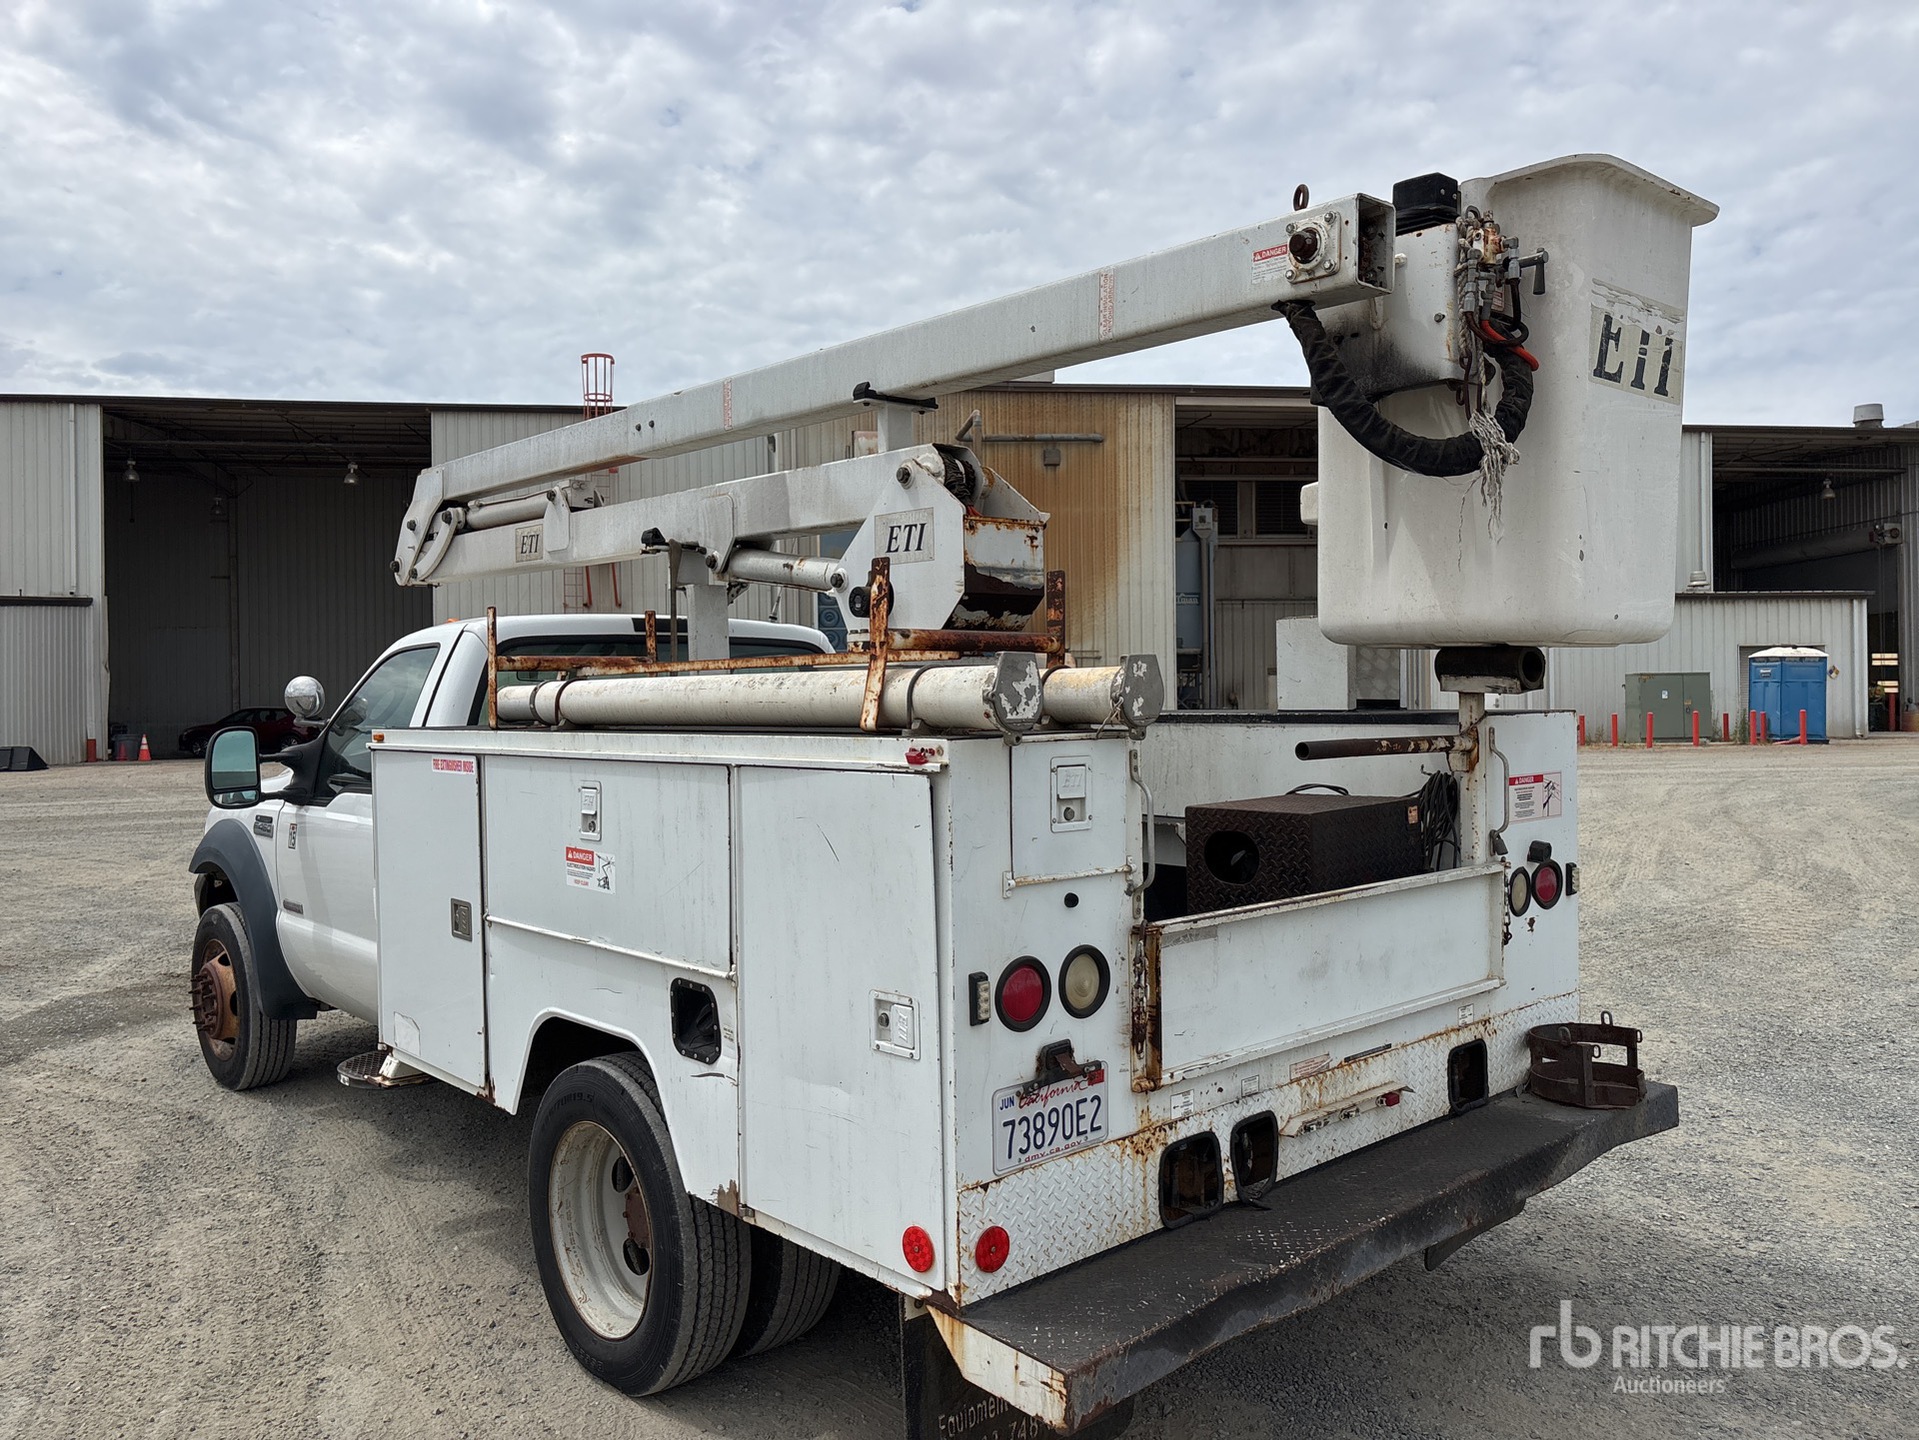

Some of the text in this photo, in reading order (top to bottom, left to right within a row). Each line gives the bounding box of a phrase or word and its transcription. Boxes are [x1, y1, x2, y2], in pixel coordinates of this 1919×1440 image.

[1262, 246, 1287, 260] DANGER
[520, 533, 540, 554] ETI
[885, 523, 927, 554] ETI
[1519, 776, 1534, 784] DANGER
[573, 851, 593, 862] DANGER
[999, 1080, 1088, 1111] JUN California
[1002, 1094, 1102, 1160] 73890E2
[1024, 1139, 1083, 1163] dmv.ca.gov
